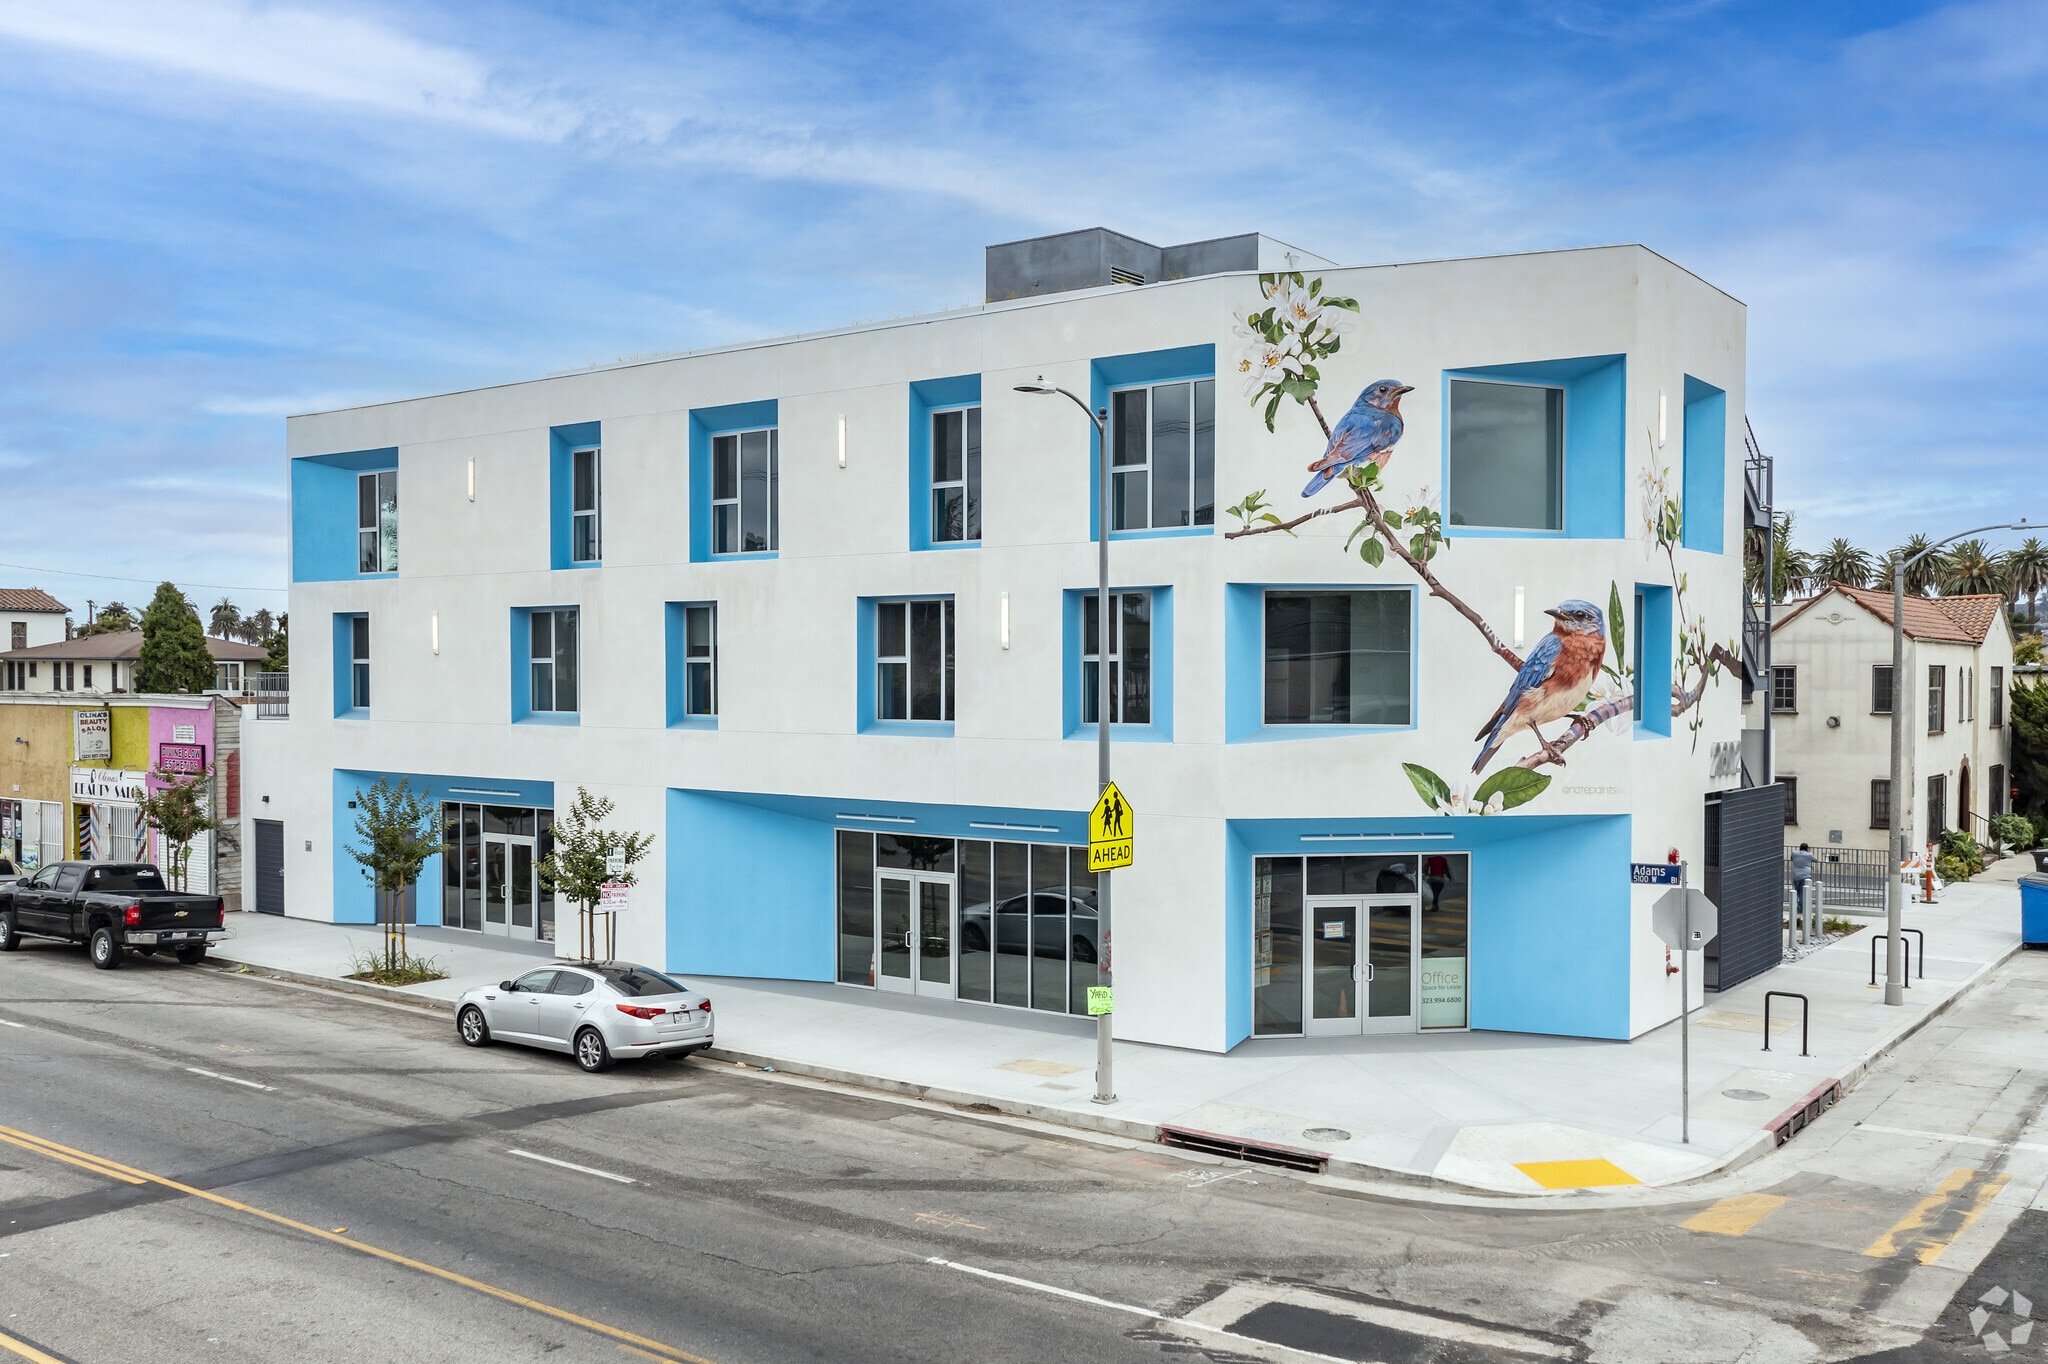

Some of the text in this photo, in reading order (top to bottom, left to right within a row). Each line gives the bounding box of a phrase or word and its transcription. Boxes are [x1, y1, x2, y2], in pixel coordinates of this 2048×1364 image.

[162, 747, 201, 760] DIVINE GLOW
[165, 759, 198, 770] ESTHETICS
[74, 782, 110, 797] BEAUTY
[1093, 845, 1131, 863] AHEAD
[1633, 865, 1666, 877] Adams
[1421, 971, 1459, 984] Office
[1089, 988, 1108, 999] YARD
